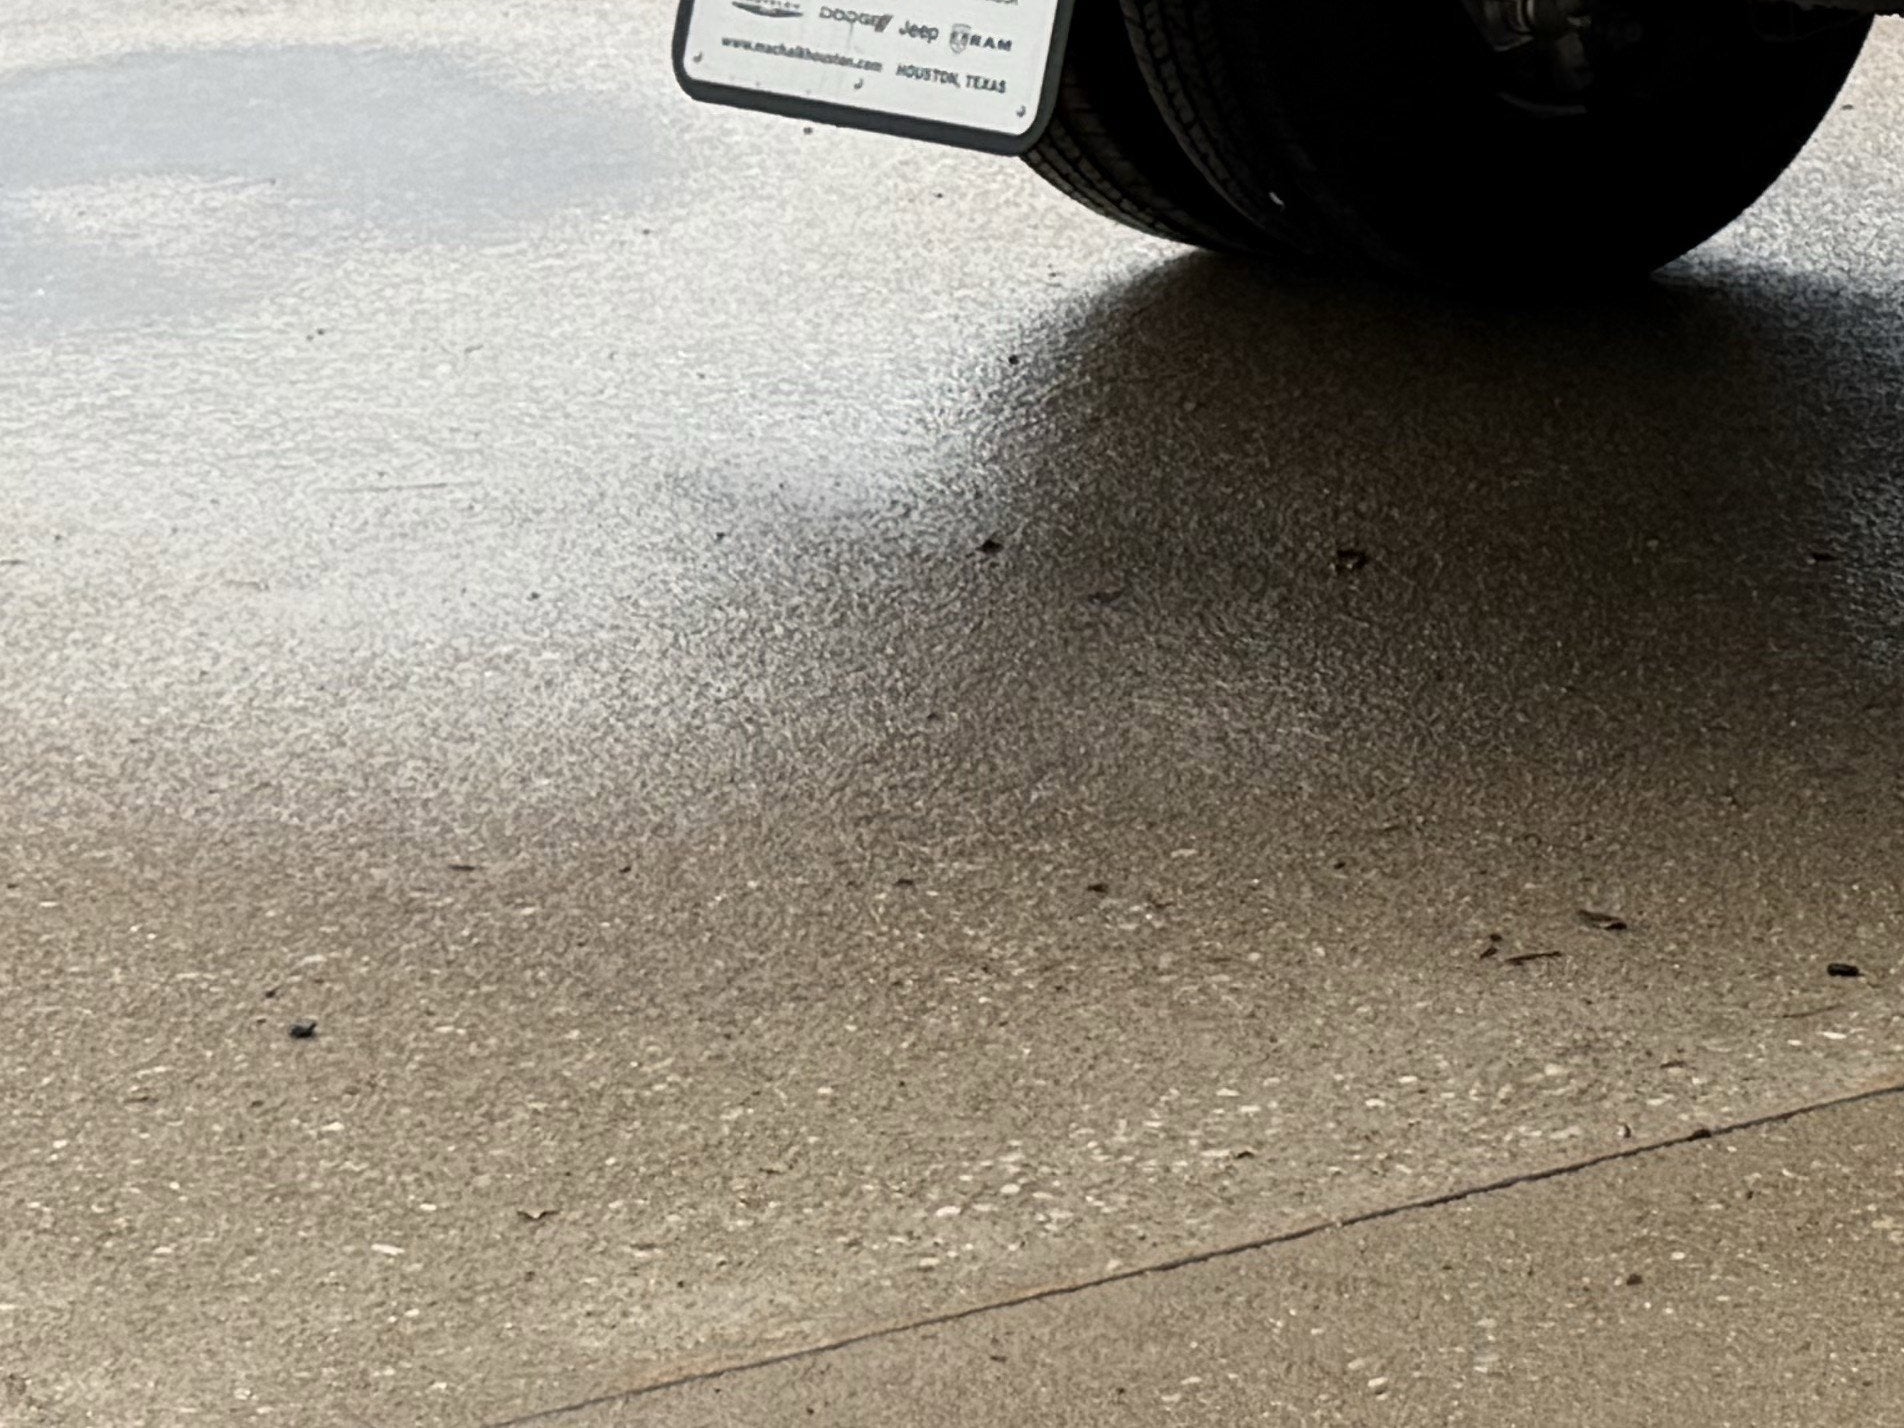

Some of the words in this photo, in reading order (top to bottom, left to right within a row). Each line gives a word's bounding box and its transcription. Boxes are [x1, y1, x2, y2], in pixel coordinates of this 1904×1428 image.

[899, 20, 940, 43] Jeep
[969, 35, 1012, 53] RAM
[965, 74, 1007, 94] TEXAS
